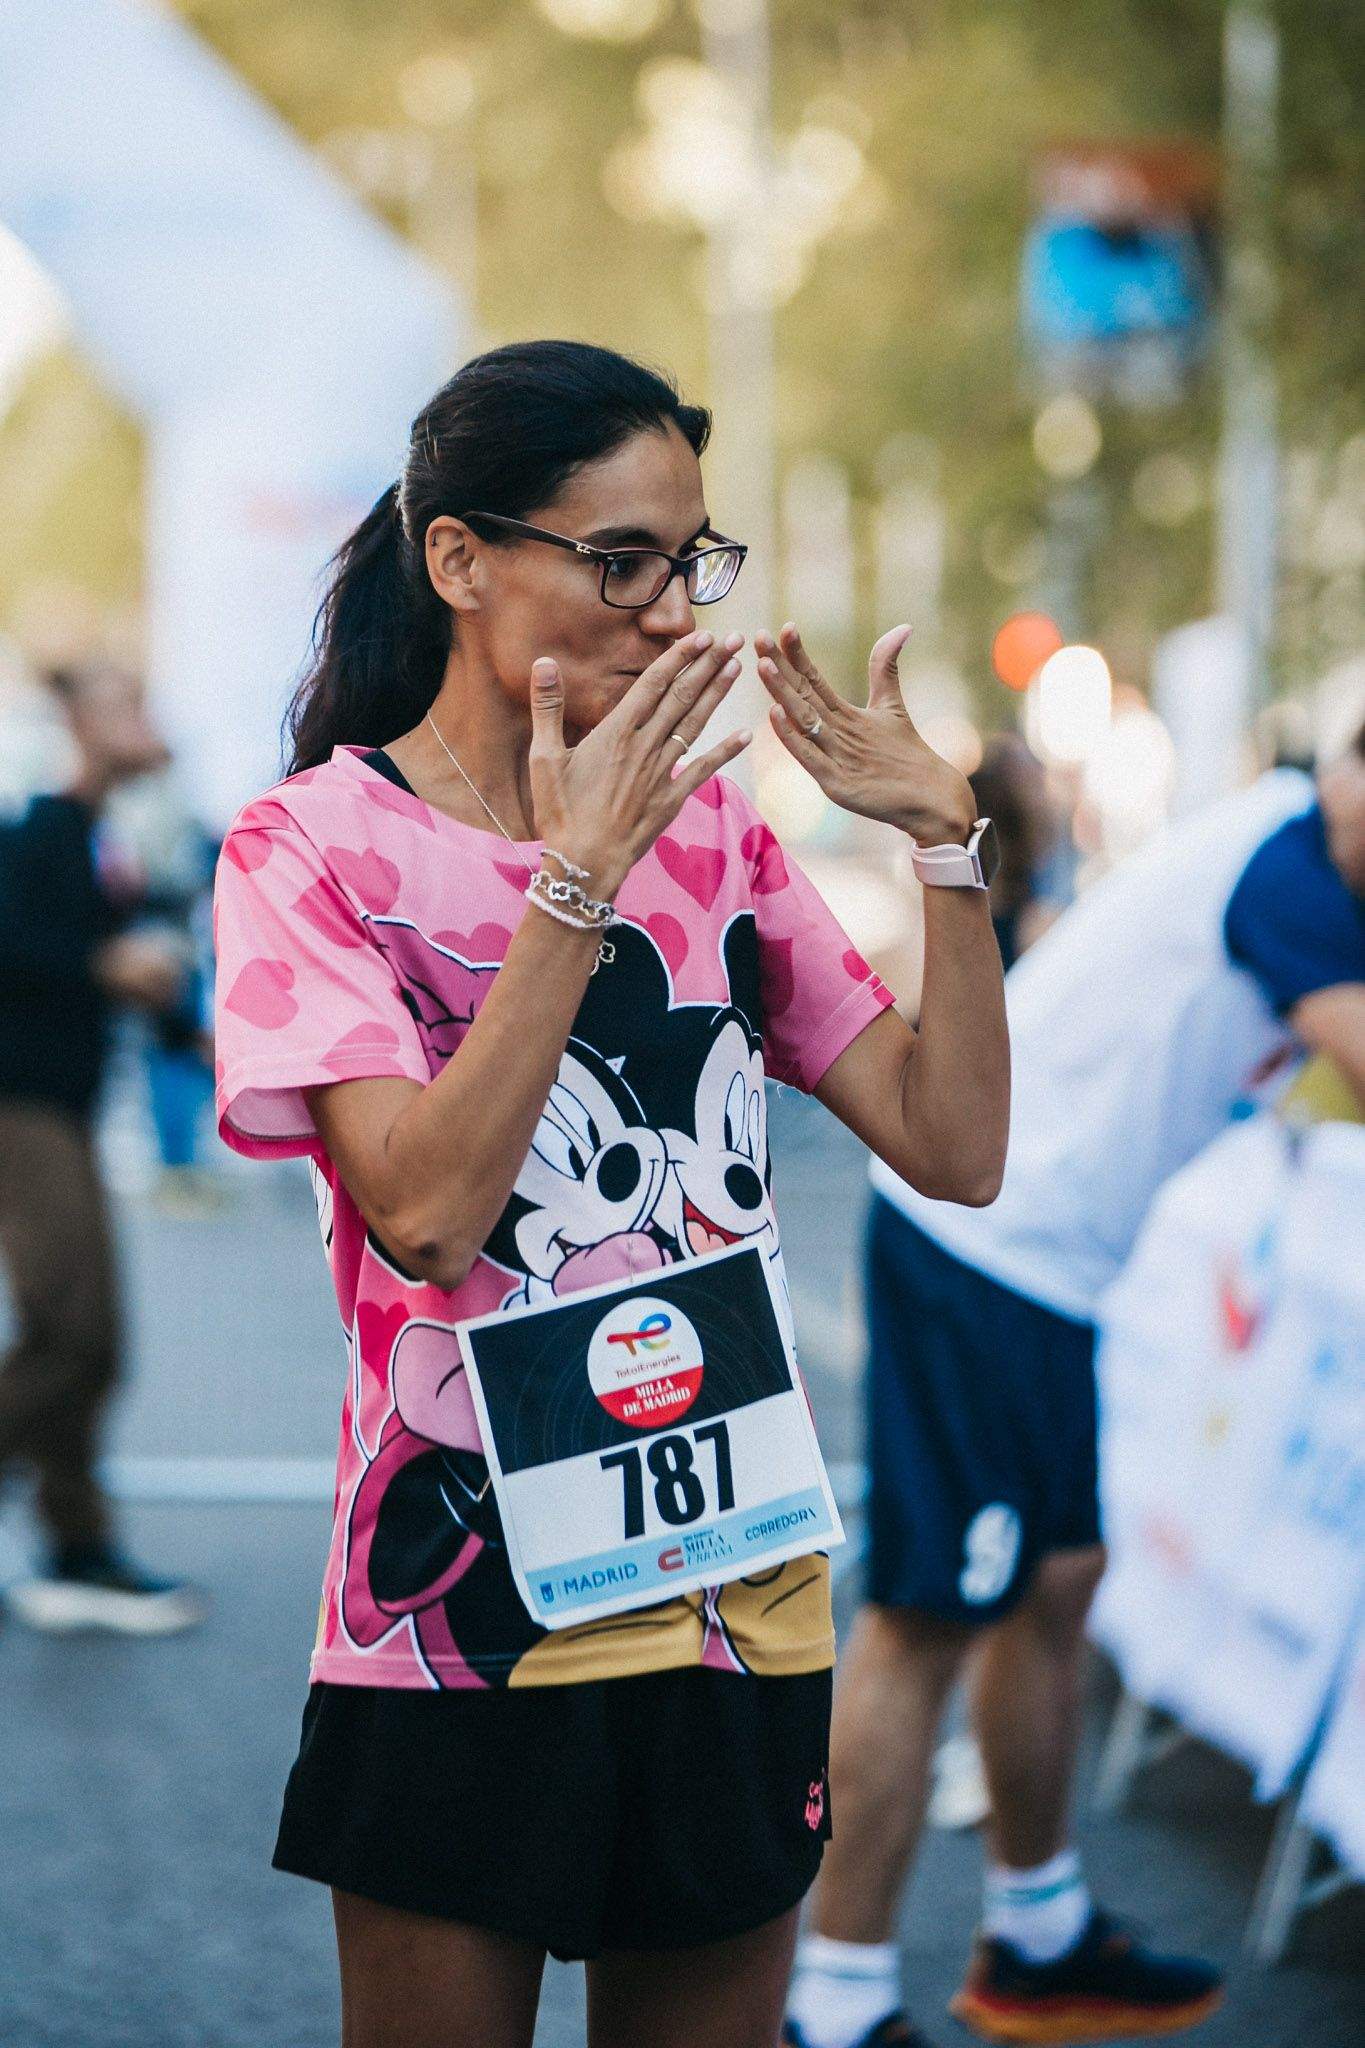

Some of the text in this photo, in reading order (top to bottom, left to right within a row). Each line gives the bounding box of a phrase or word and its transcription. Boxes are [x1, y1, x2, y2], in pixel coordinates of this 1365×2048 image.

[615, 1354, 681, 1379] TotalEnergies
[622, 1386, 691, 1417] DE MADRID
[634, 1377, 674, 1400] MILLA
[599, 1419, 736, 1540] 787
[563, 1562, 638, 1595] MADRID
